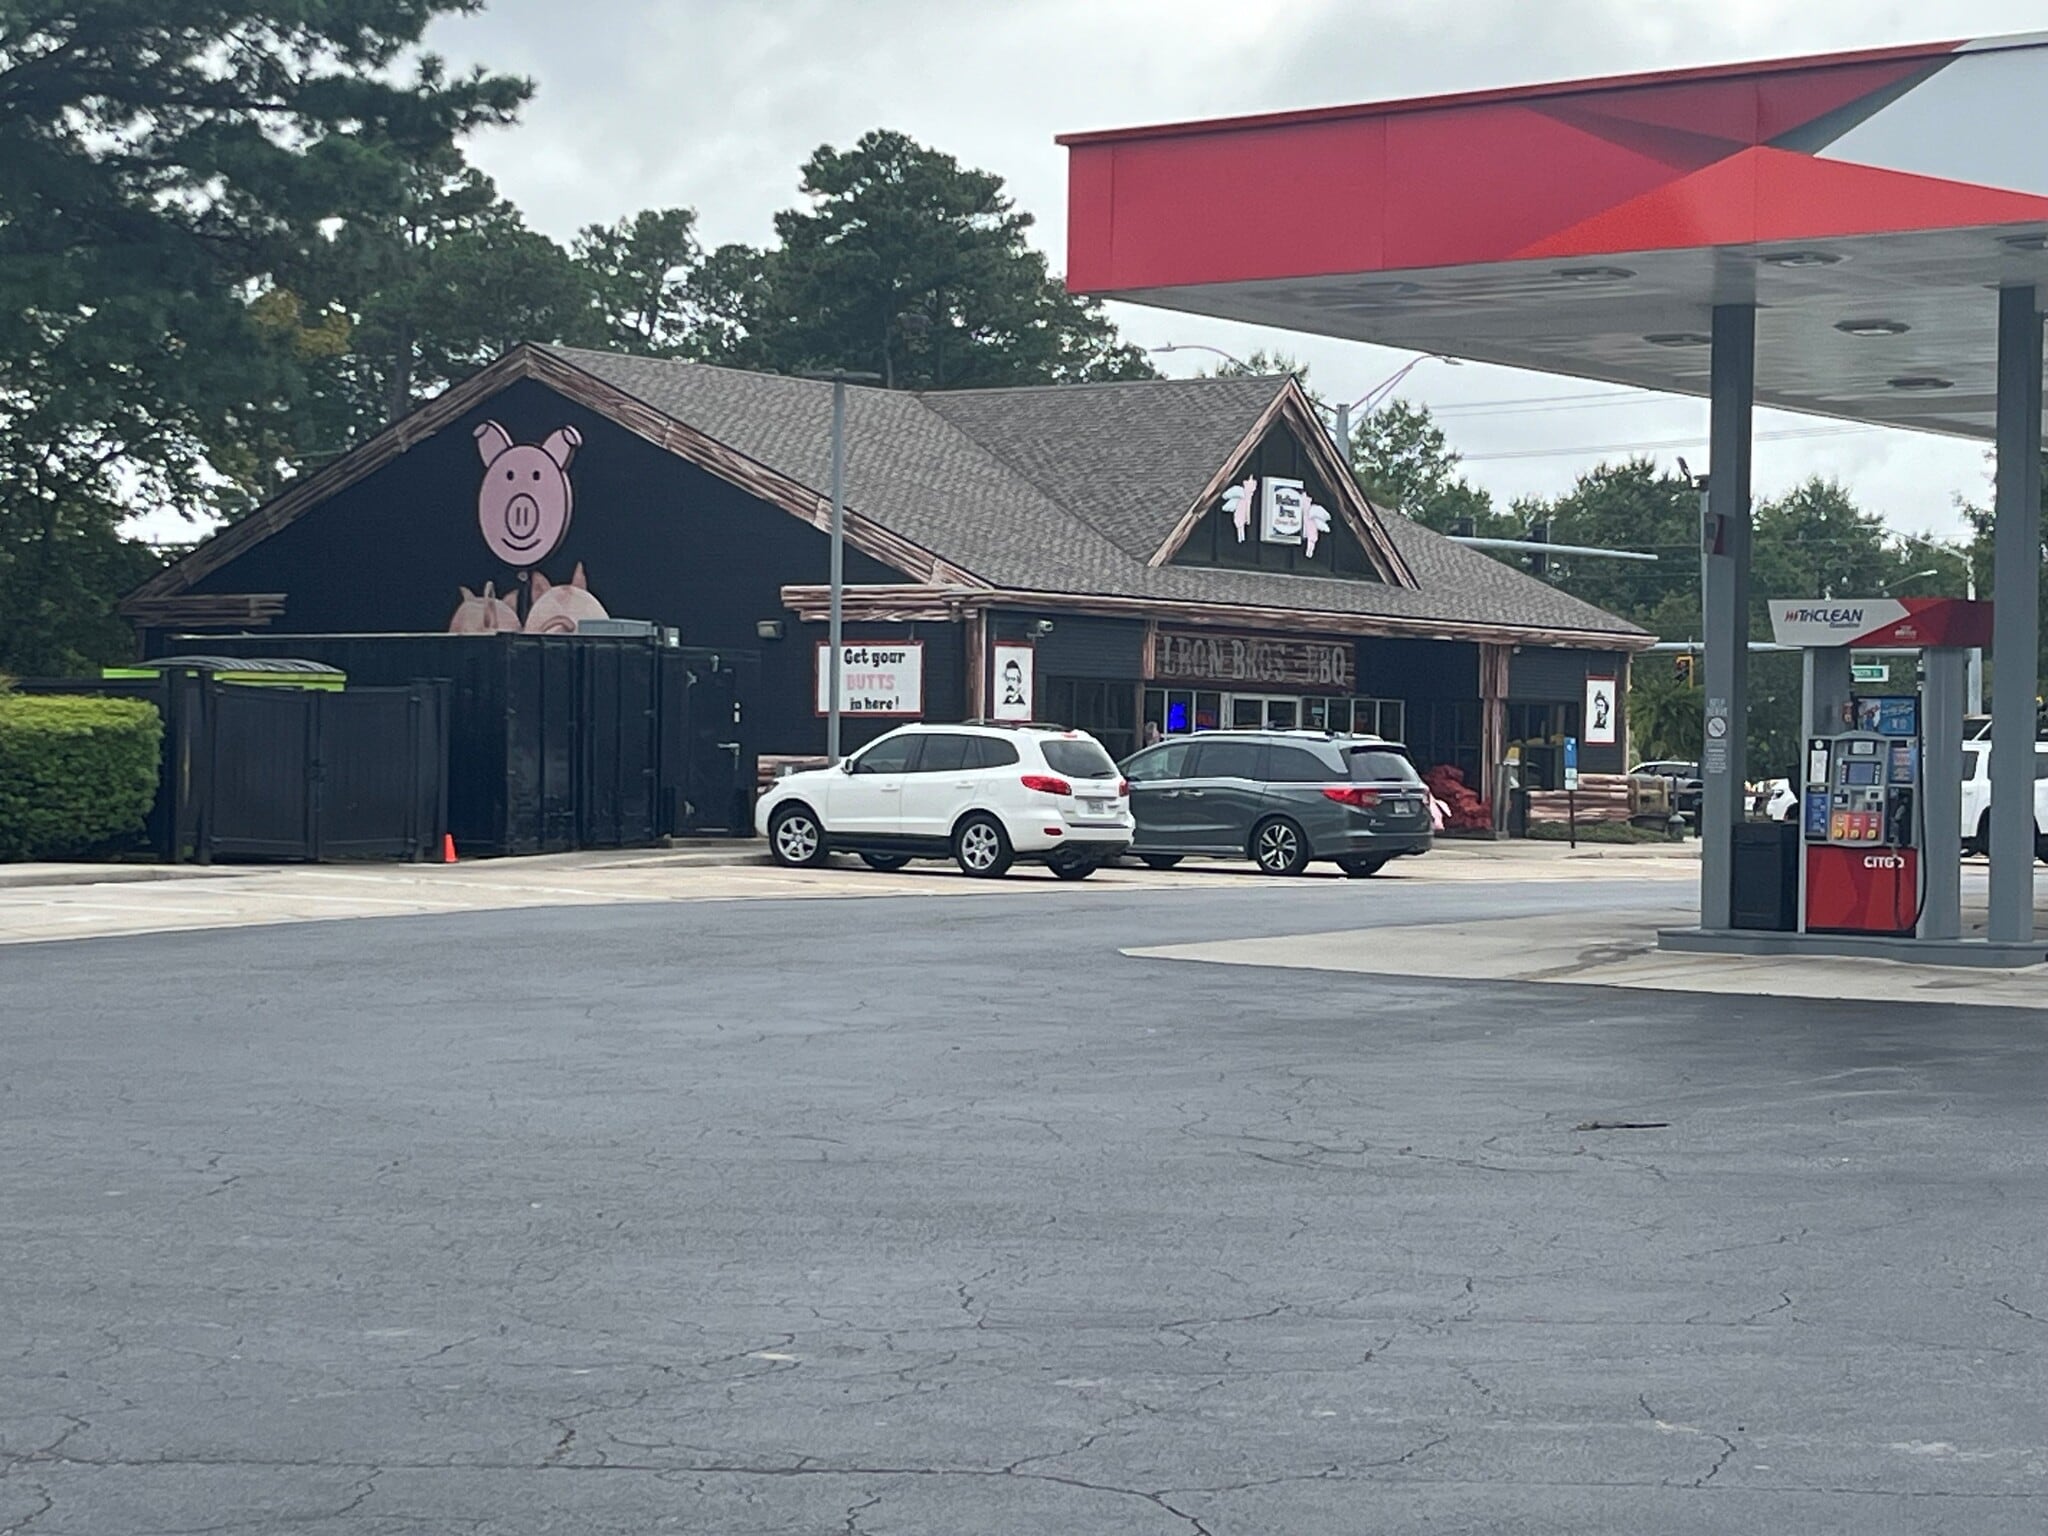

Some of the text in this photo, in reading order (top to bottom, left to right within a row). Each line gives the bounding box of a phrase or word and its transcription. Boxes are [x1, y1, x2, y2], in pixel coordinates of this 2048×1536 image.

[844, 648, 905, 668] Get your
[846, 673, 896, 691] BUTTS
[850, 697, 862, 710] in
